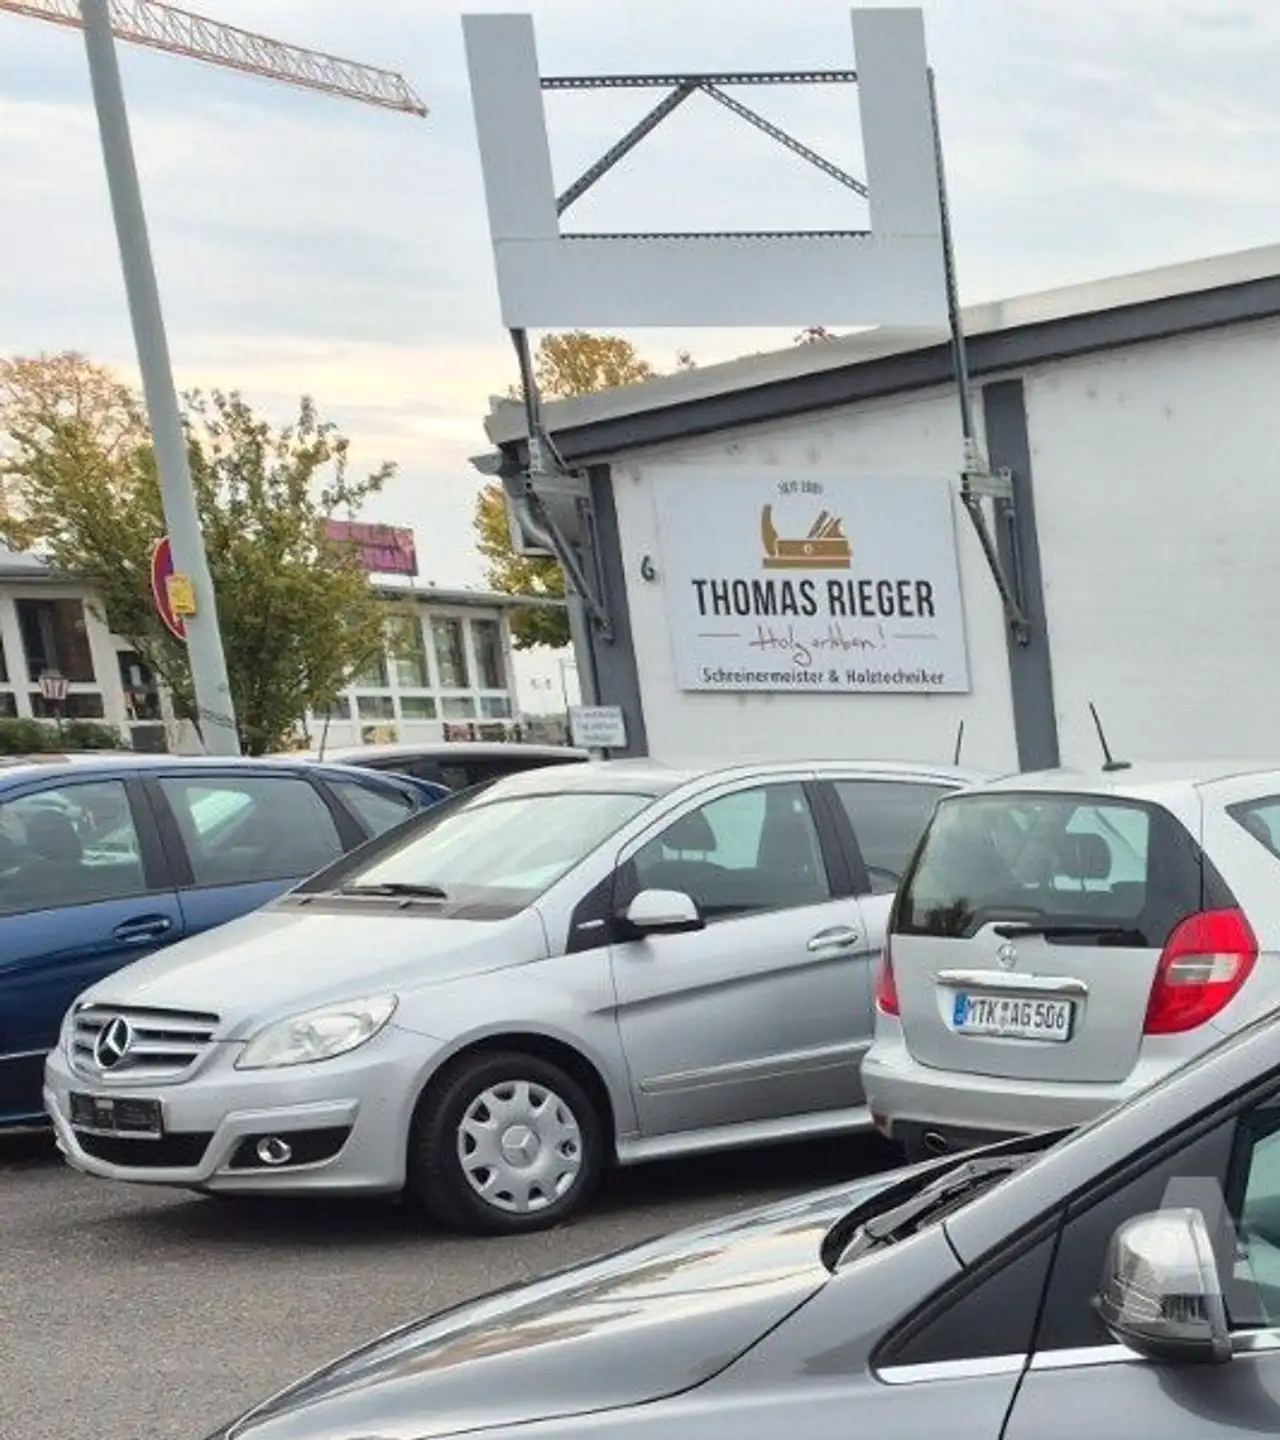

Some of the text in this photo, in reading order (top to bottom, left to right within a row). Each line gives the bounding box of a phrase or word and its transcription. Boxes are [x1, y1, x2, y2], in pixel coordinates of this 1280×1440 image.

[691, 579, 935, 617] THOMAS RIEGER
[702, 666, 945, 685] Schreinermeister & Holztechniker
